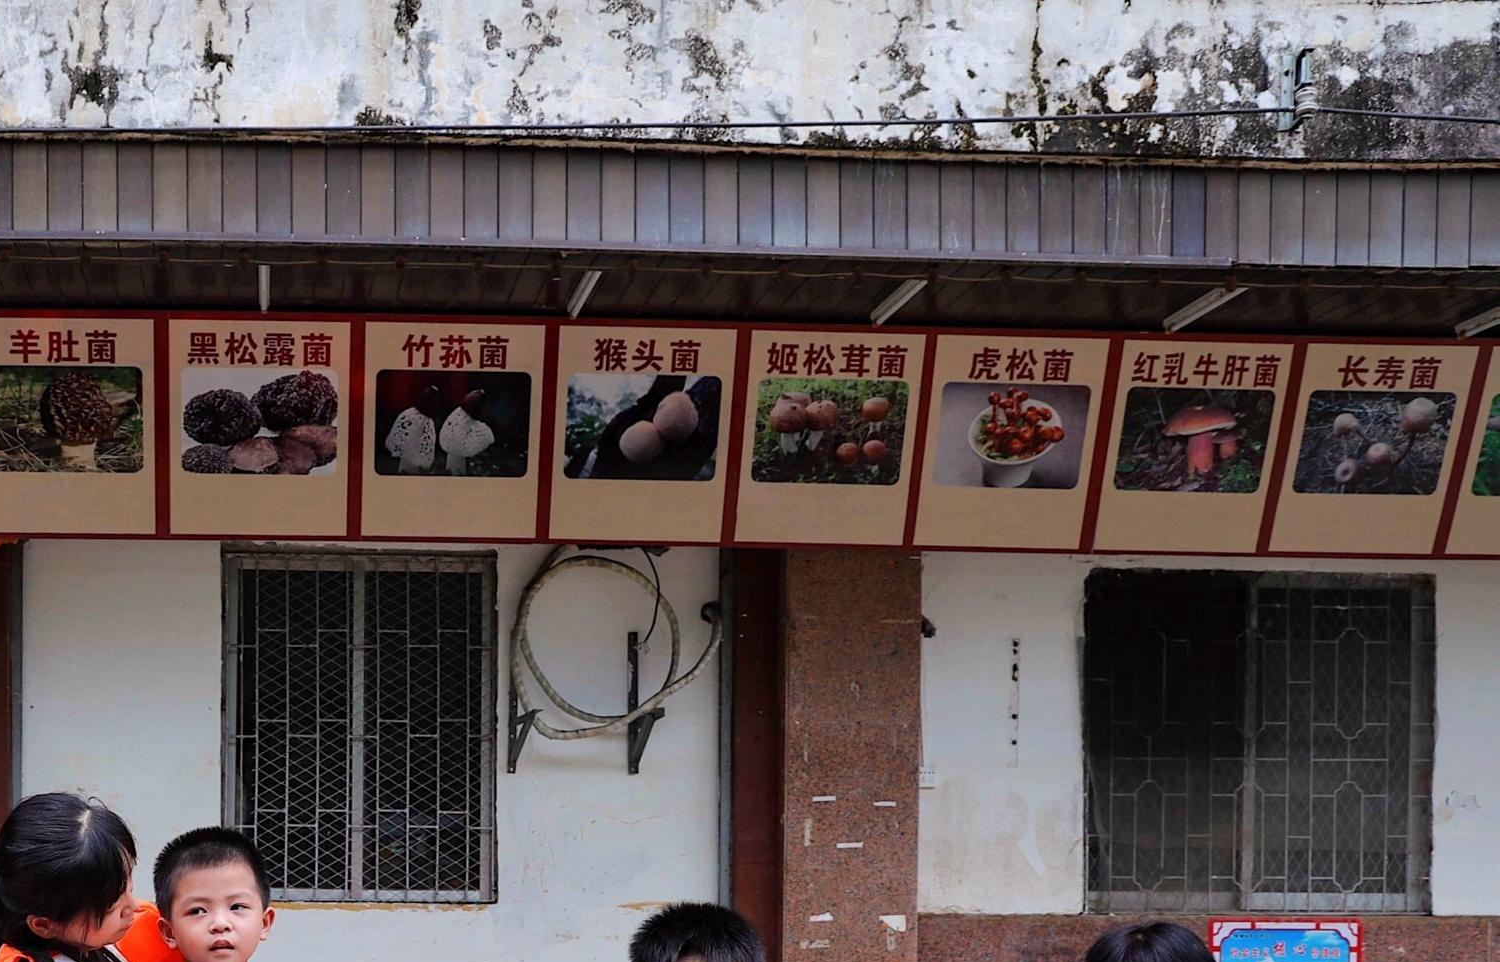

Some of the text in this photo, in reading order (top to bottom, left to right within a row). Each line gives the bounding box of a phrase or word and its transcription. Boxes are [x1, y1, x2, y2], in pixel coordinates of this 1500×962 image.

[10, 330, 117, 364] 羊肚菌
[188, 332, 333, 367] 黑松露菌
[402, 334, 509, 369] 竹荪菌
[594, 338, 701, 373] 猴头菌
[767, 342, 908, 378] 姬松茸菌
[969, 347, 1073, 382] 虎松菌
[1132, 352, 1281, 388] 红乳牛肝菌
[1338, 355, 1442, 389] 长寿菌
